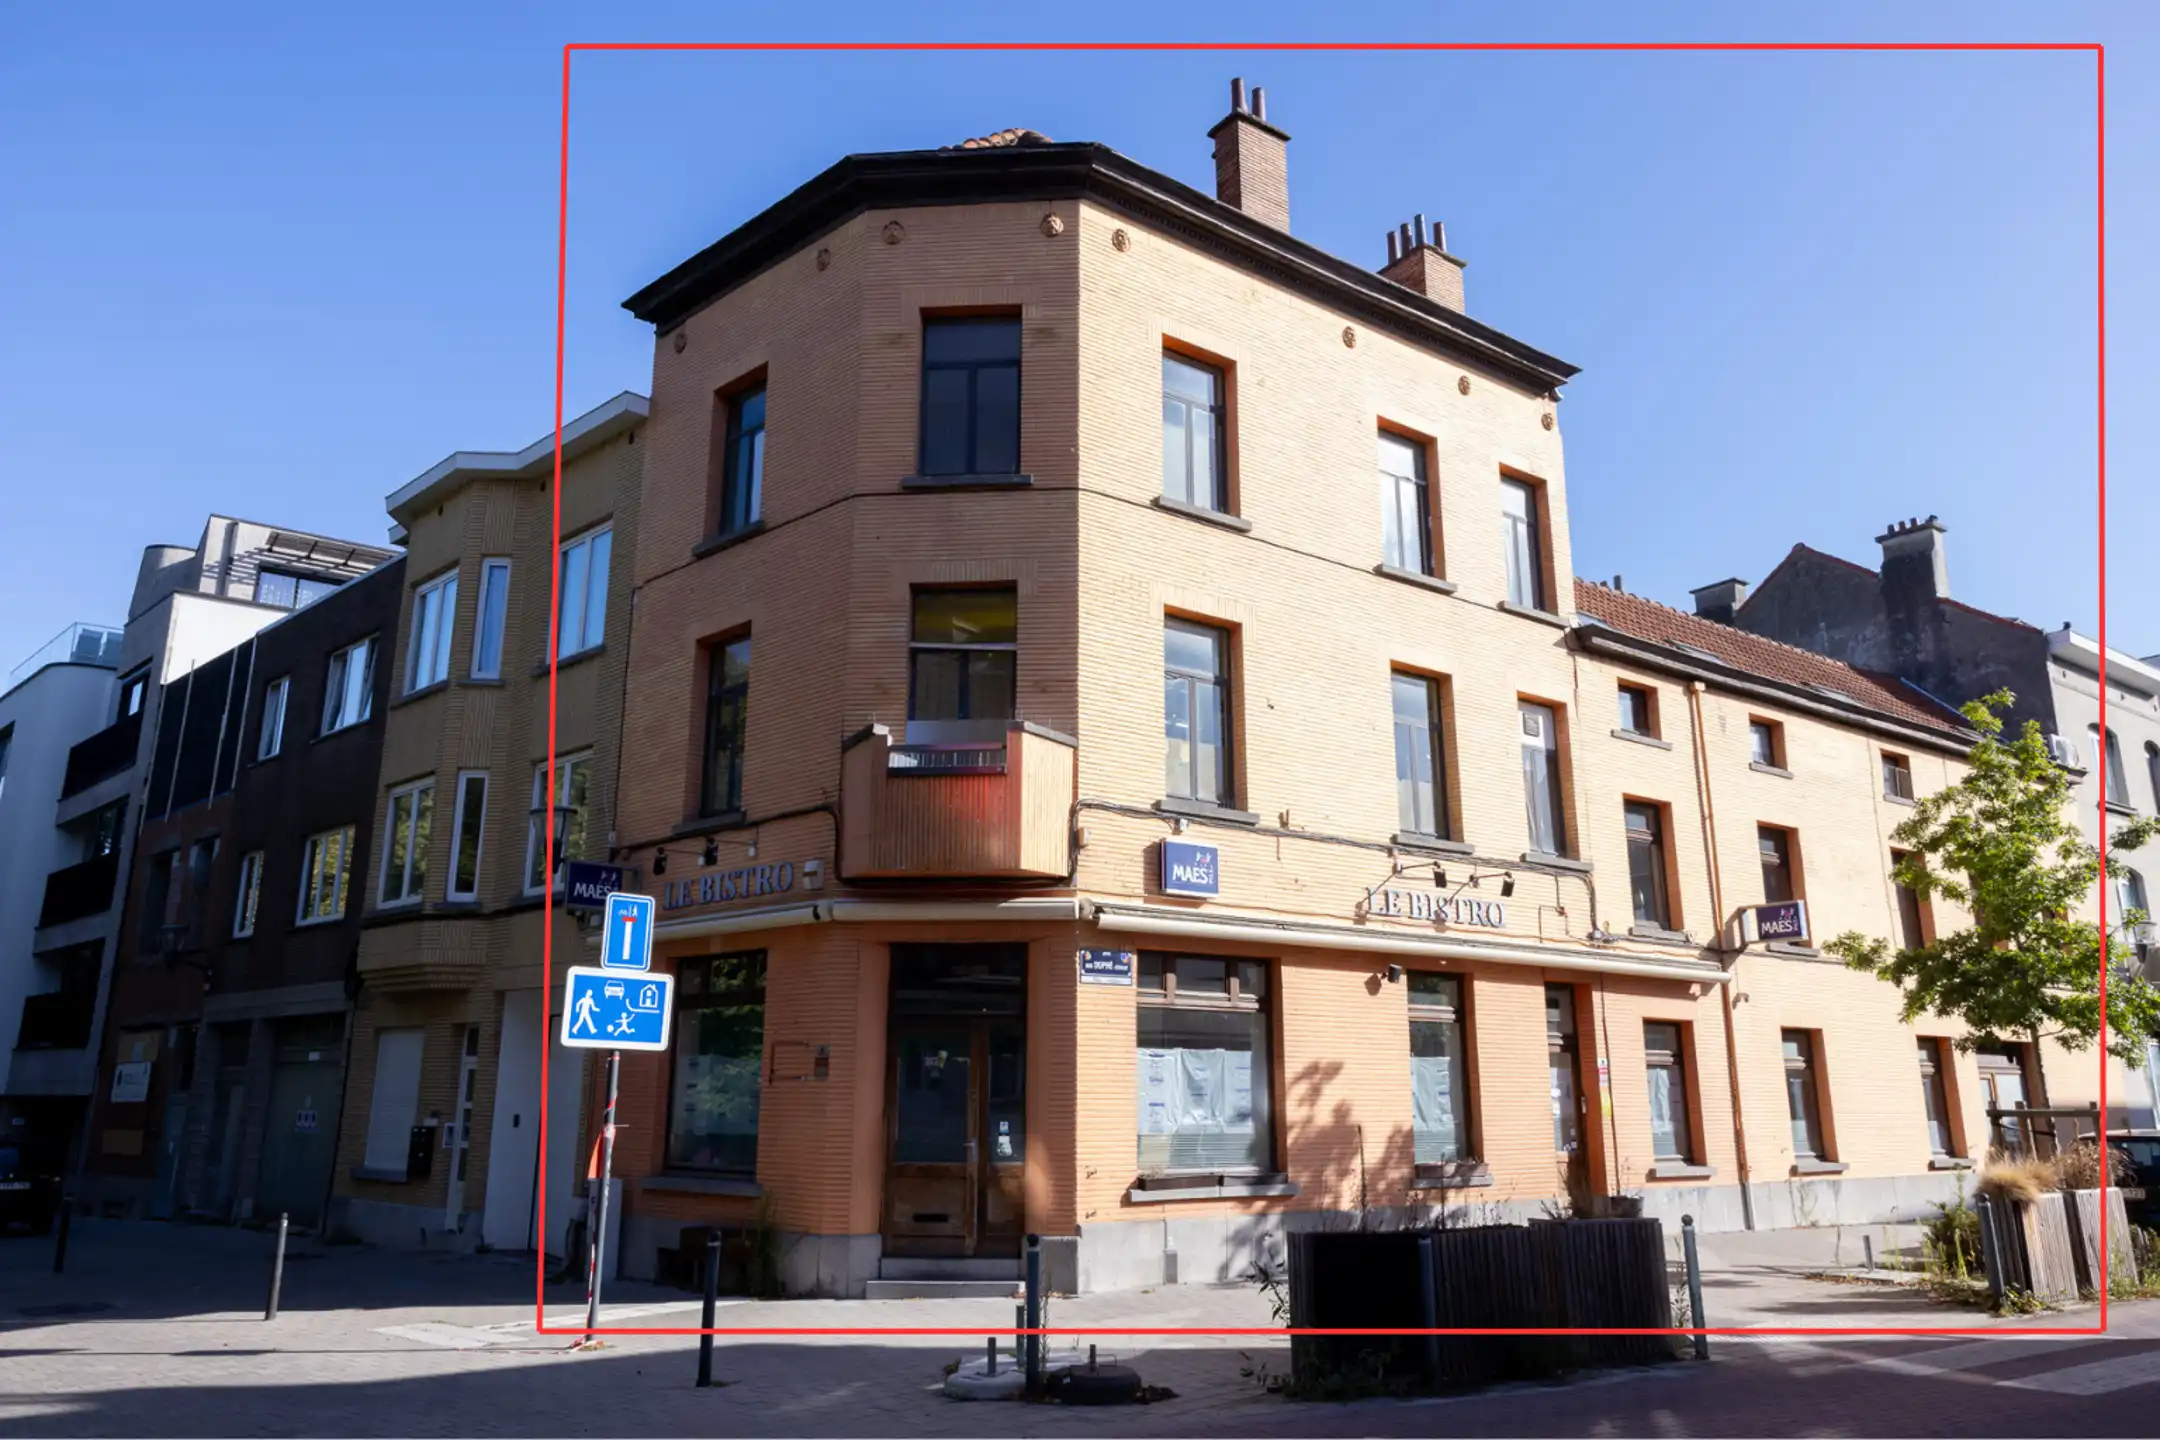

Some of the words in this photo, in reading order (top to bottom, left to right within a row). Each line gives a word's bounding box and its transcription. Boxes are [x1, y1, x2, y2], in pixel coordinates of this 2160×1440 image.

[1172, 864, 1208, 884] MAES
[573, 882, 612, 899] MAES
[663, 880, 694, 910] LE
[699, 862, 793, 904] BISTRO
[1365, 887, 1402, 917] LE
[1408, 892, 1504, 928] BISTRO
[1762, 920, 1792, 934] MAES
